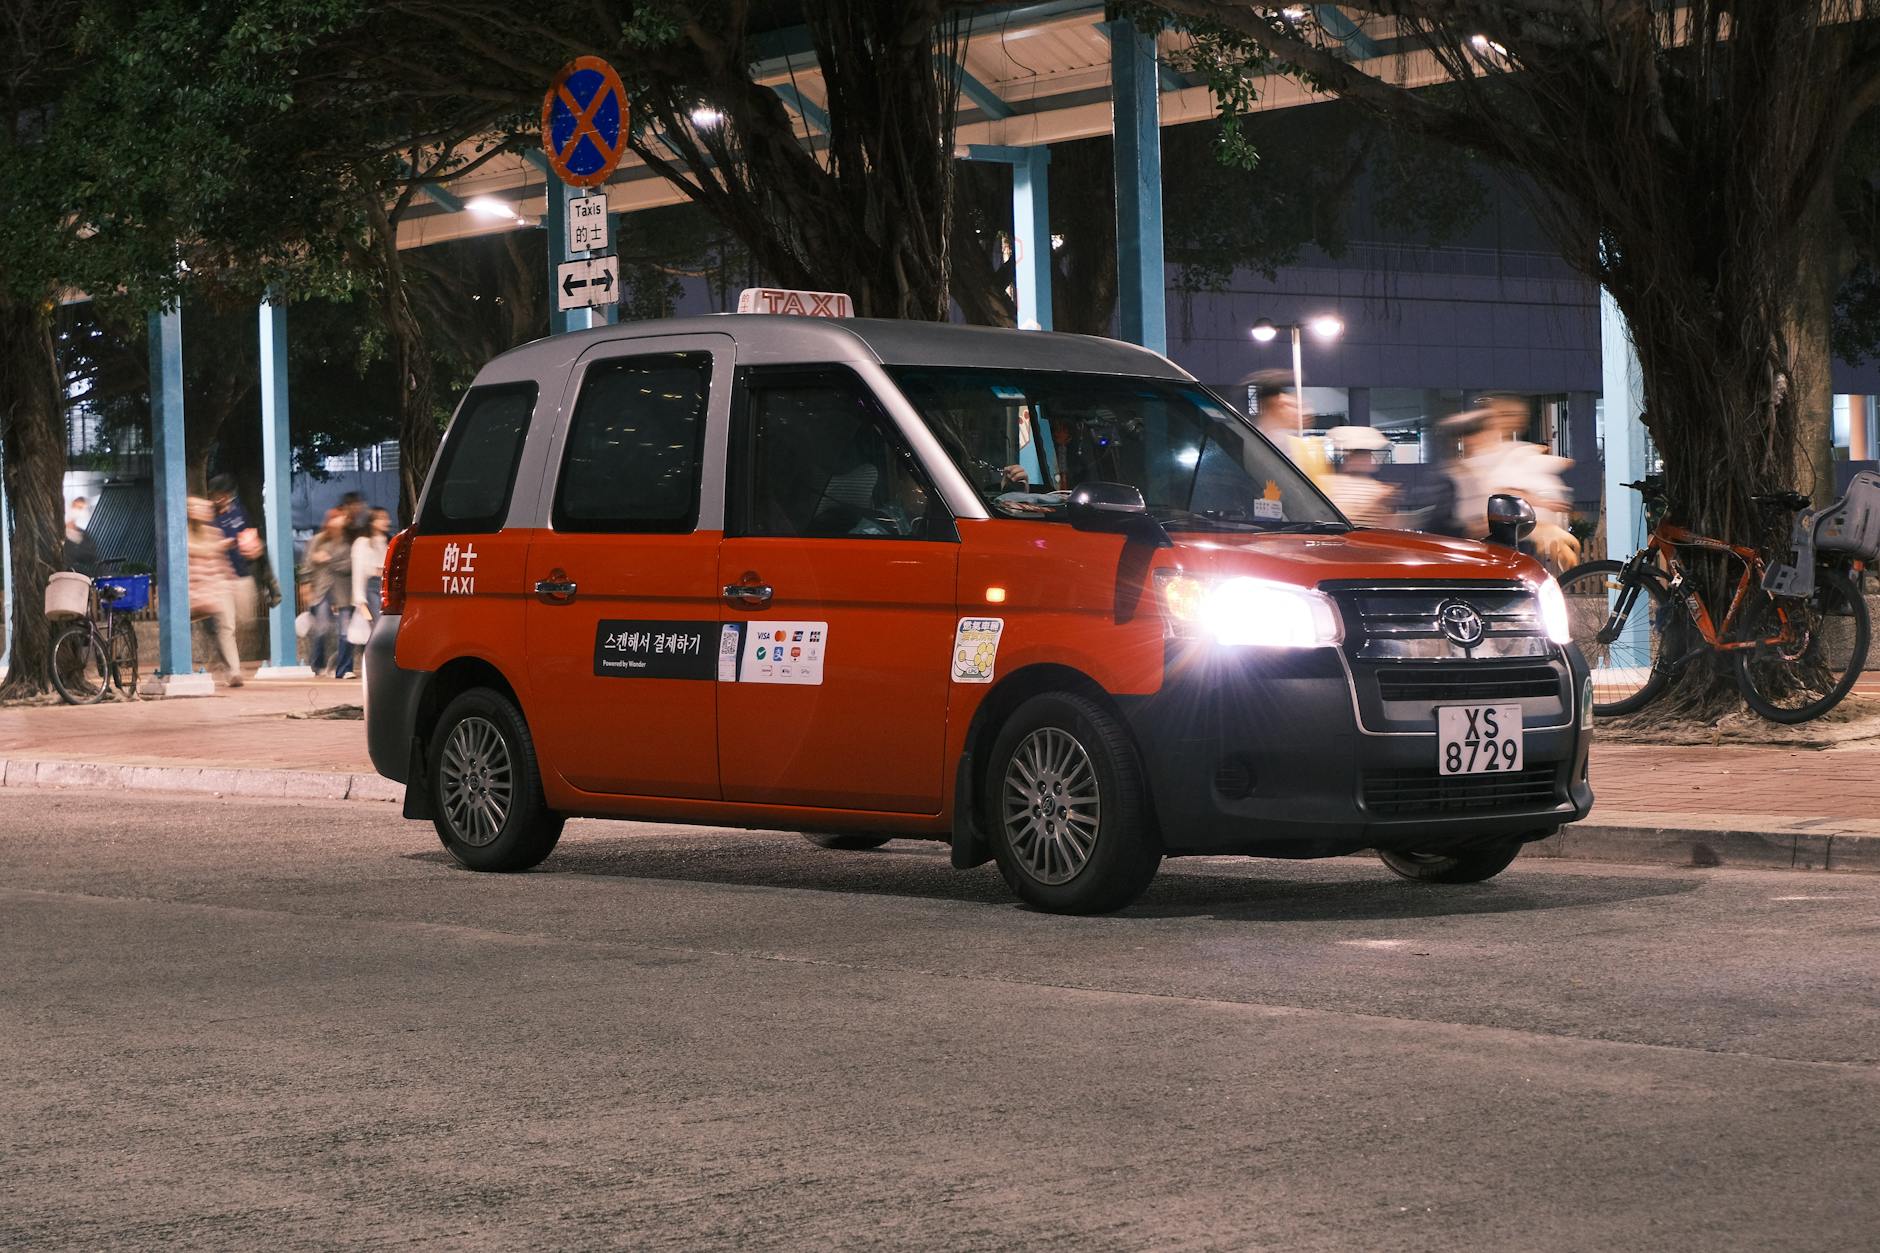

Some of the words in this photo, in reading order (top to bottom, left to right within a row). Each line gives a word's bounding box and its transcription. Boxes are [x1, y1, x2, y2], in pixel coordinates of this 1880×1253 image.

[575, 203, 601, 217] Taxis
[576, 224, 602, 243] 的士
[762, 290, 846, 318] TAXI
[442, 542, 478, 573] 的士
[442, 576, 475, 595] TAXI
[604, 632, 650, 653] 스캔해서
[653, 633, 701, 655] 결제하기
[757, 632, 771, 640] VISA
[602, 659, 622, 667] Powered
[622, 660, 629, 669] by
[629, 660, 647, 668] Wonder
[1465, 708, 1499, 740] XS
[1446, 739, 1518, 773] 8729
